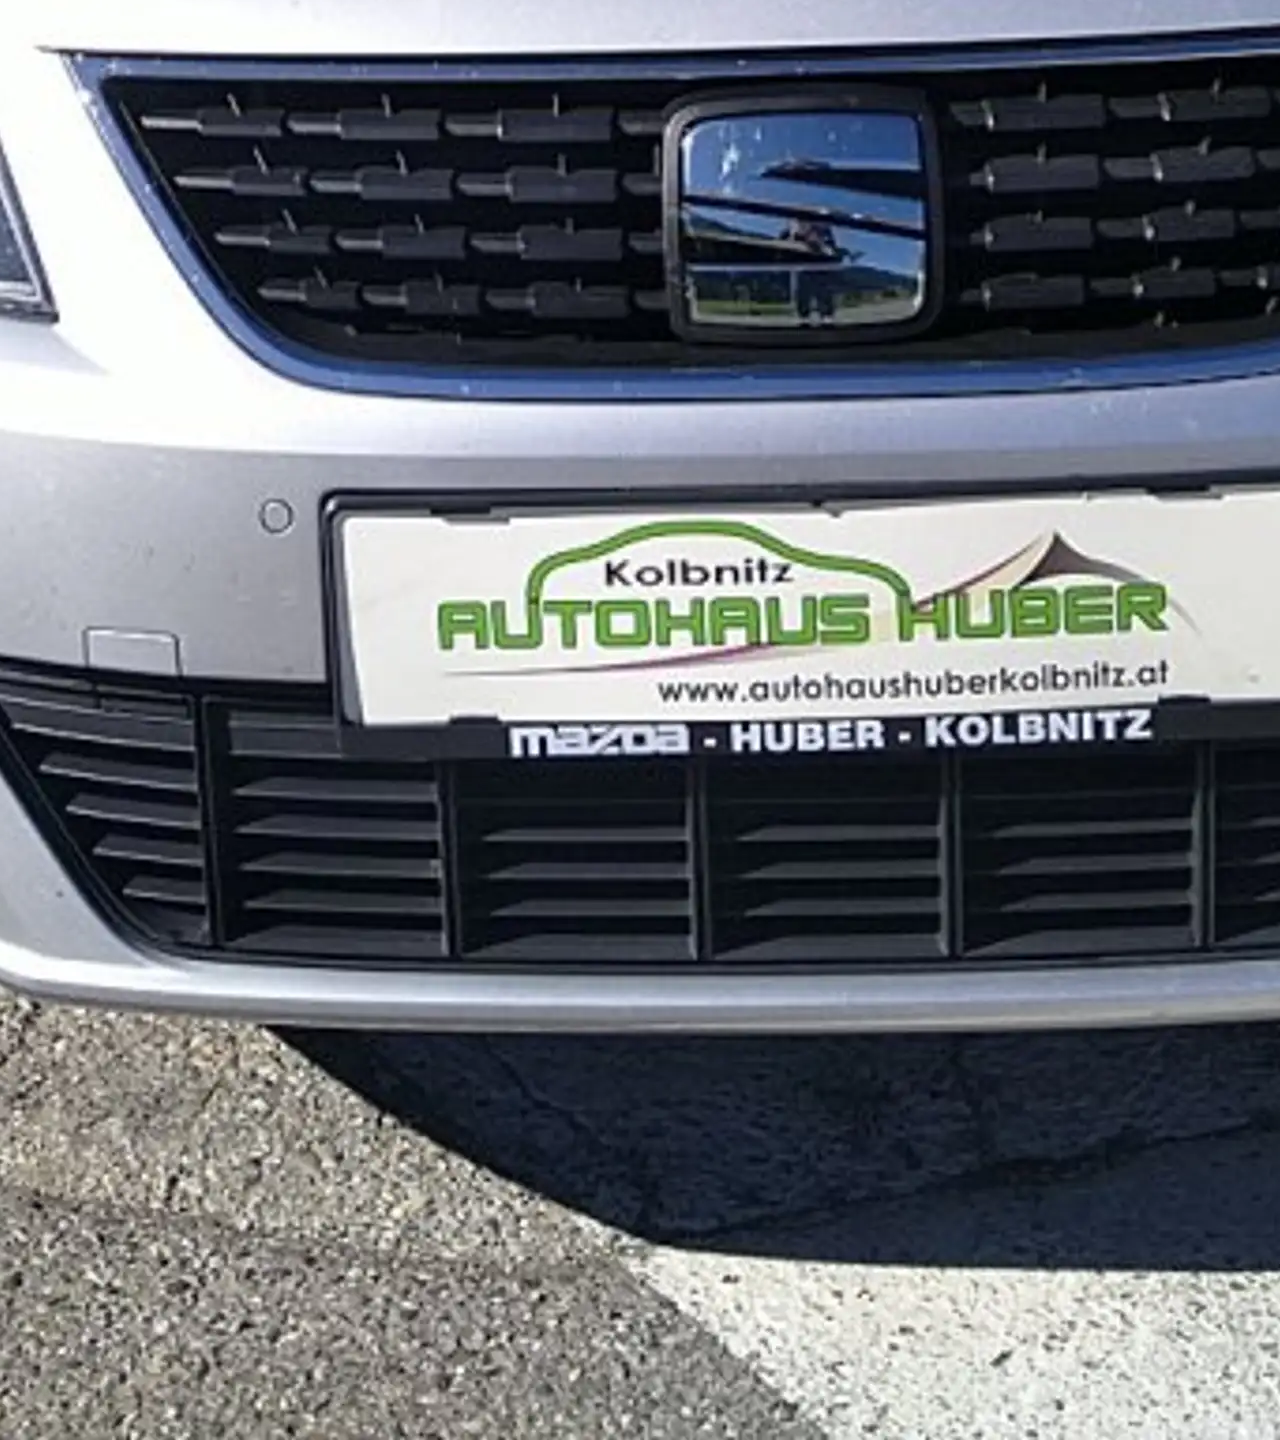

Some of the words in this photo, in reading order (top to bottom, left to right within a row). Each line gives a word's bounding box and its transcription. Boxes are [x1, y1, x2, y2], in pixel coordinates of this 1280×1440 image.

[605, 558, 795, 587] Kolbnitz
[437, 593, 871, 650] AUTOHAUS
[898, 583, 1169, 643] HUBER
[657, 659, 1170, 704] www.autohaushuberkolbnitz.at
[509, 723, 692, 758] mazda
[730, 718, 885, 753] HUBER
[925, 708, 1154, 748] KOLBNITZ
